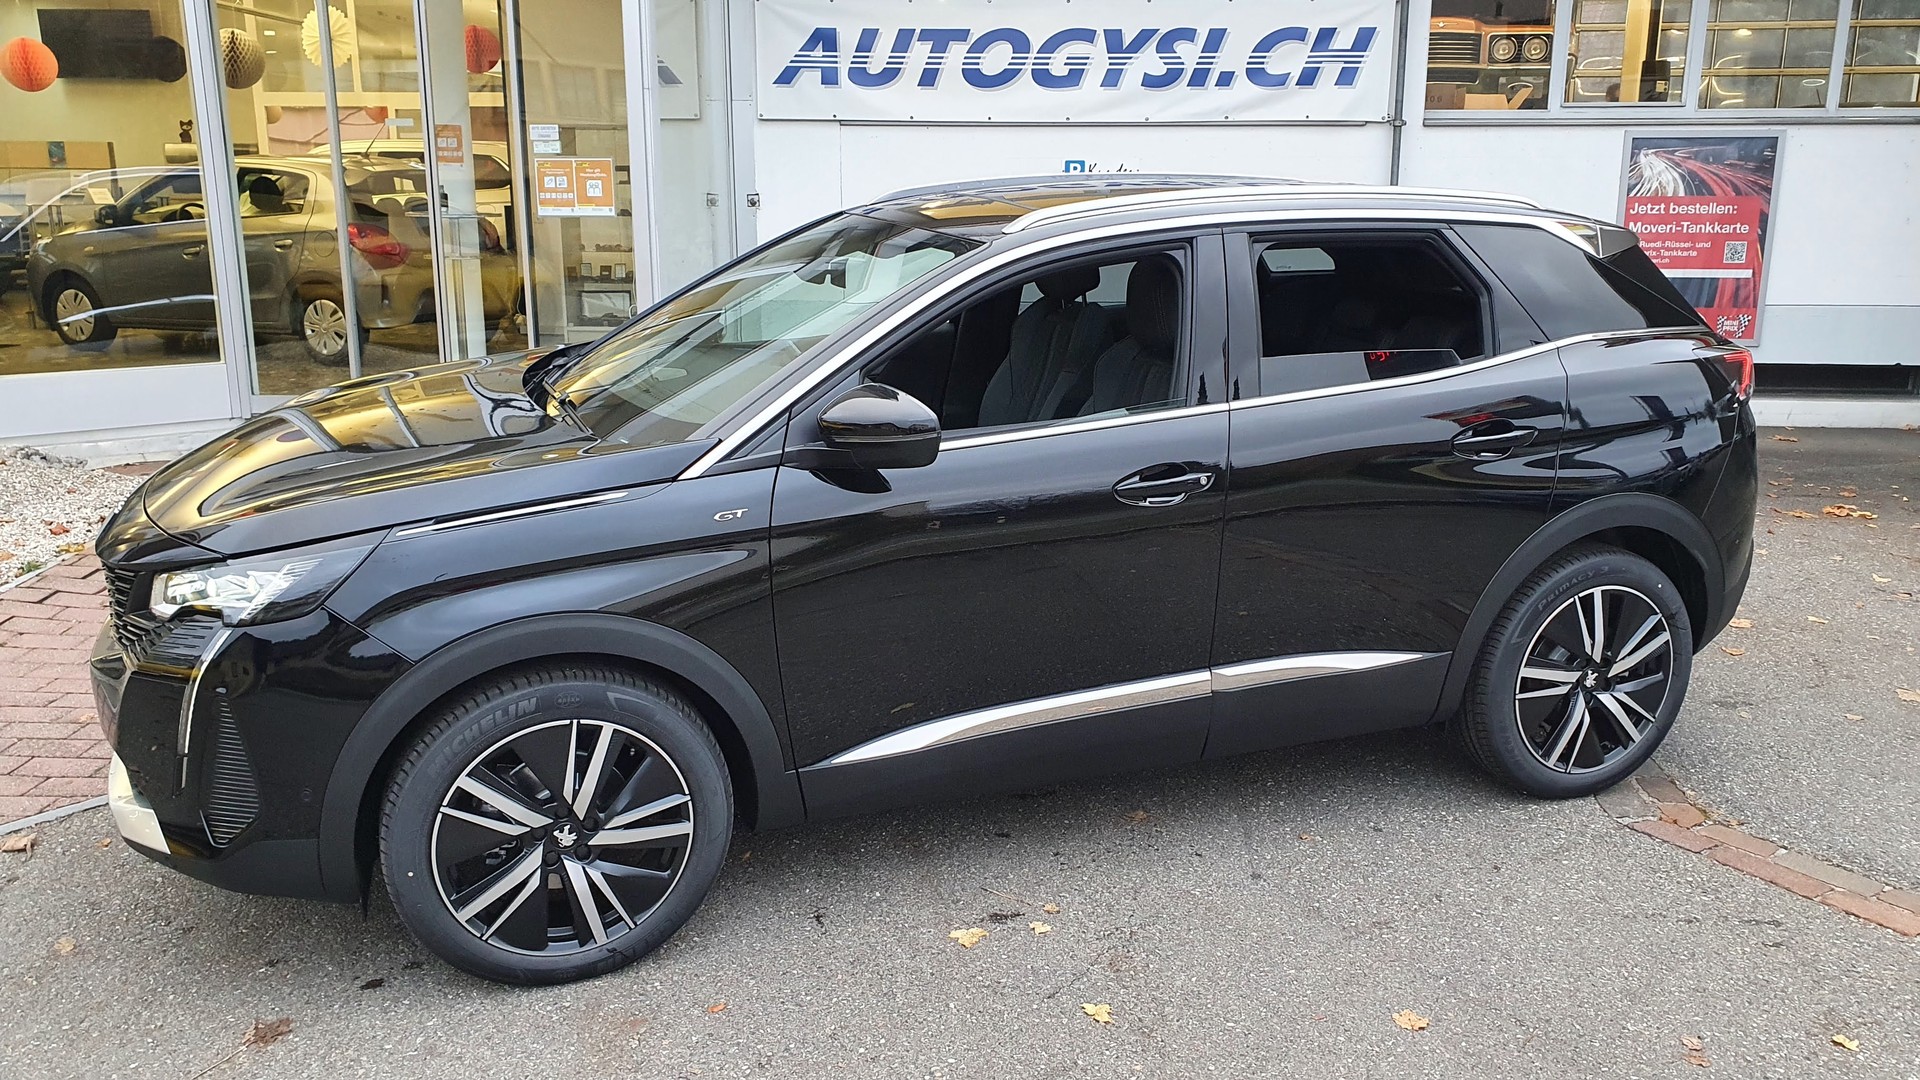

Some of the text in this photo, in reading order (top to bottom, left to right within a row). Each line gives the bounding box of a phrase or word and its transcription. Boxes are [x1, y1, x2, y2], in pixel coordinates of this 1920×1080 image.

[772, 26, 1378, 89] AUTOGYSI.CH
[1629, 202, 1738, 214] Jetzt bestellen:
[1628, 221, 1750, 233] Moveri-Tankkarte
[1695, 240, 1712, 248] und
[713, 508, 749, 521] GT
